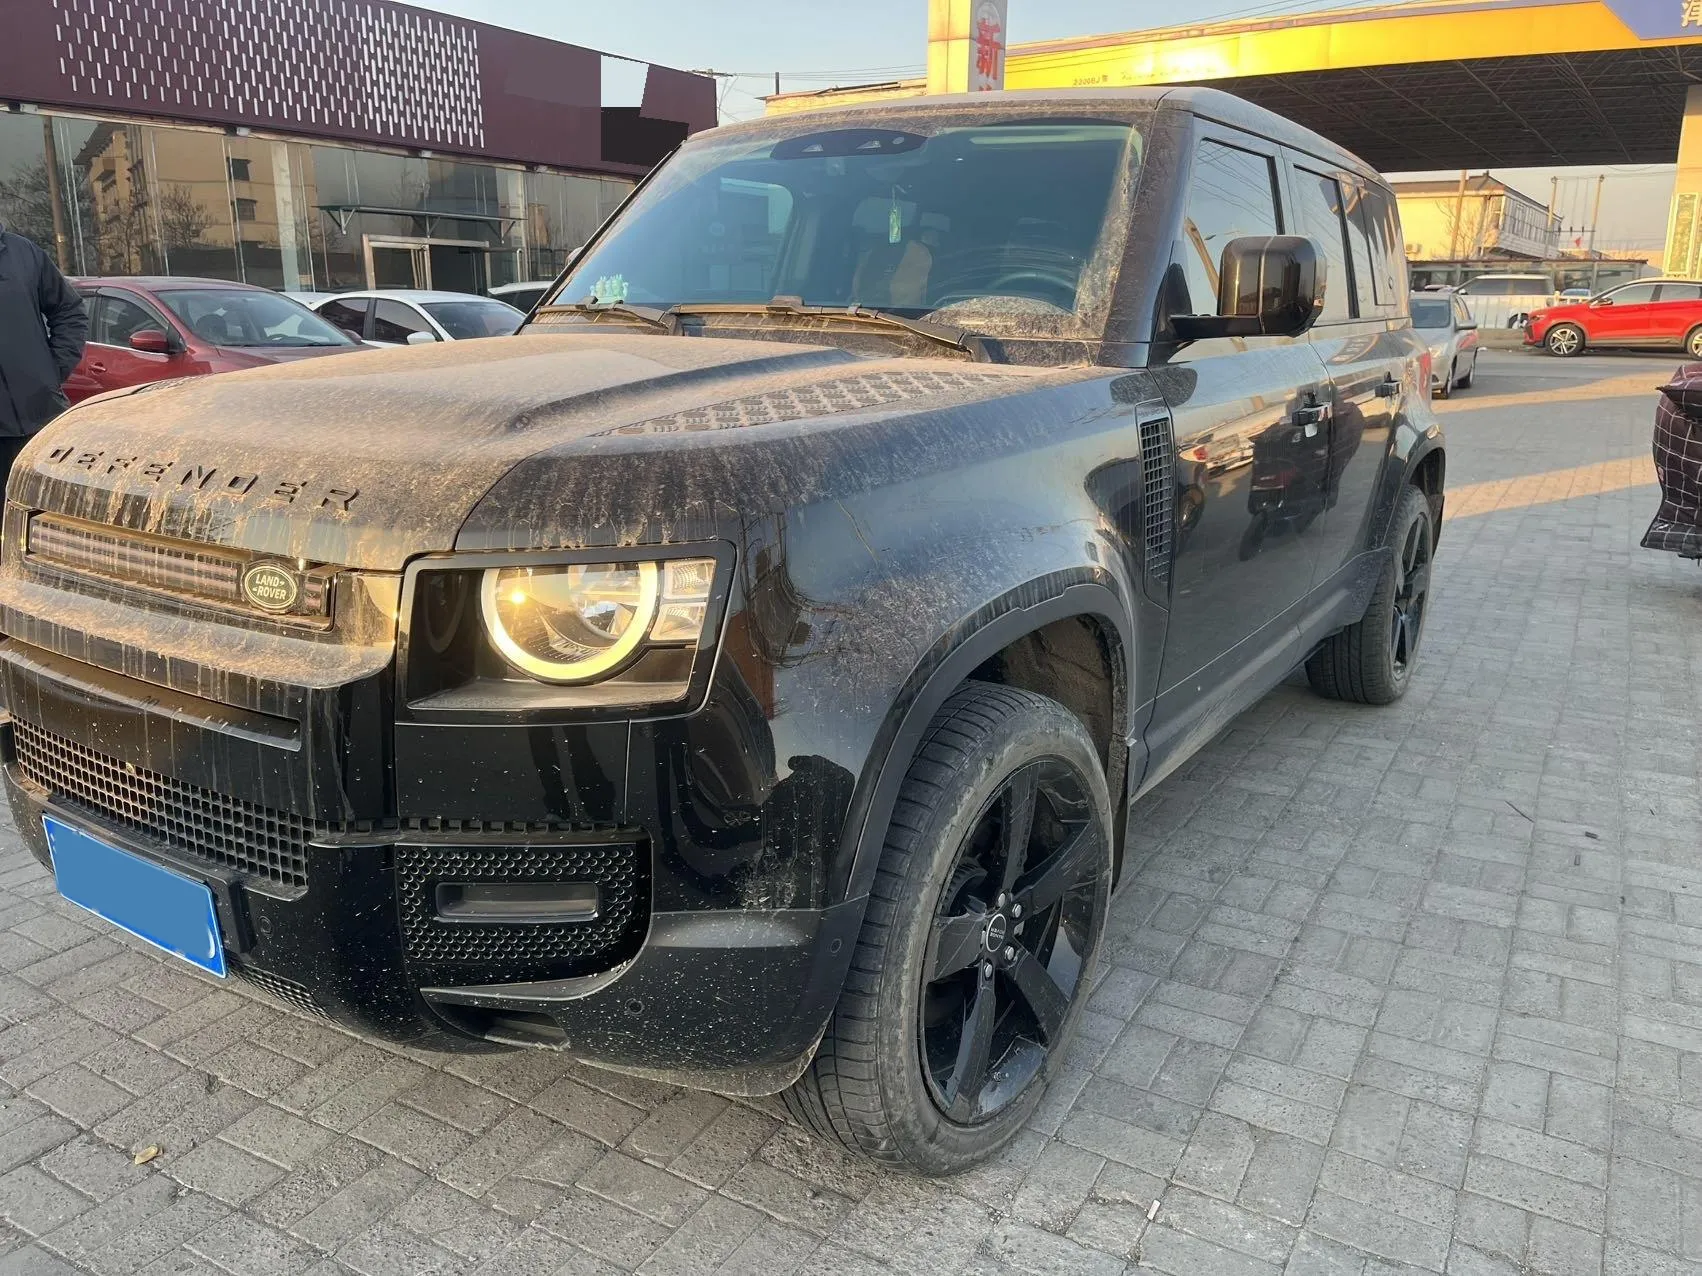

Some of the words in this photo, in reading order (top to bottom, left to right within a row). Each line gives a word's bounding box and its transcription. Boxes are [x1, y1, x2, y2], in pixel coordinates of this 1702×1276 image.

[48, 445, 361, 512] DEFENDER
[255, 573, 280, 587] LAND
[256, 585, 287, 600] ROVER
